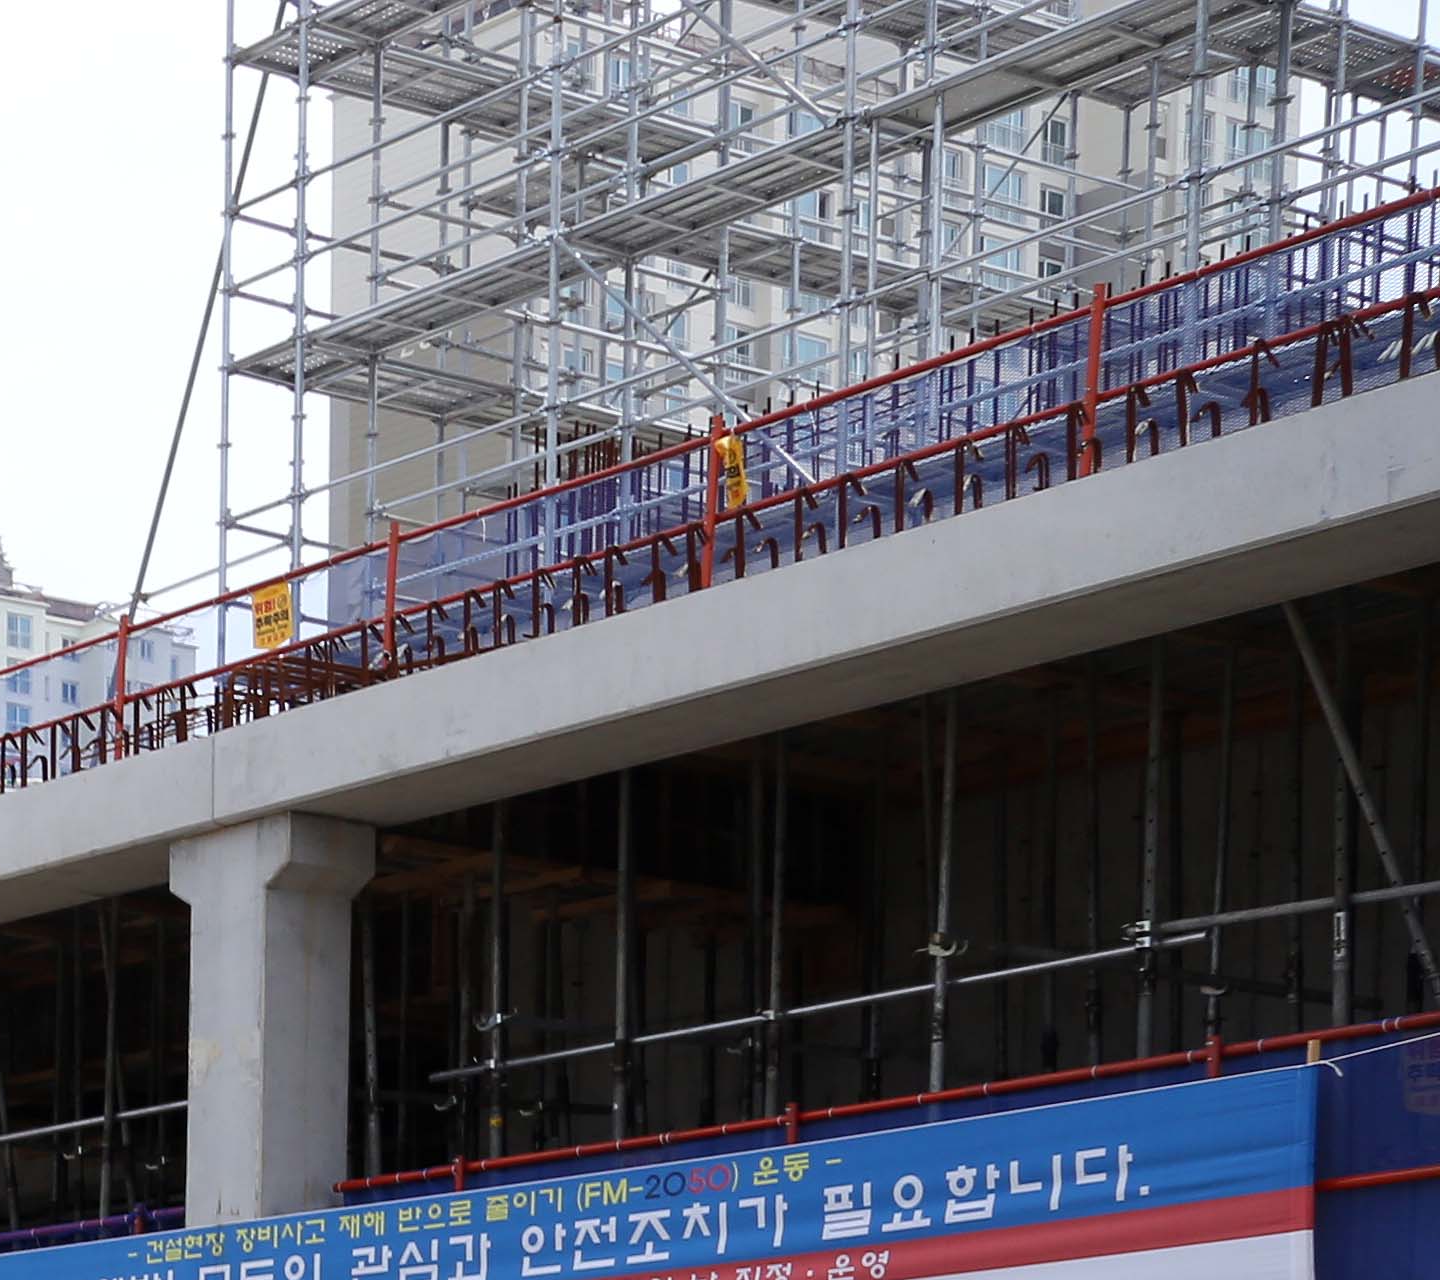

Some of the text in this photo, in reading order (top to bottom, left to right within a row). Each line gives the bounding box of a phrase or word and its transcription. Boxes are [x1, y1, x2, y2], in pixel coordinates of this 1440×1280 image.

[146, 1231, 225, 1264] 건설현장
[236, 1219, 326, 1253] 장비사고
[339, 1211, 385, 1239] 재해
[398, 1200, 472, 1233] 반으로
[486, 1187, 563, 1222] 줄이기
[577, 1161, 739, 1212] (FM-2050)
[753, 1152, 811, 1186] 운동
[521, 1193, 788, 1278] 안전조치가
[821, 1144, 1151, 1241] 필요합니다.
